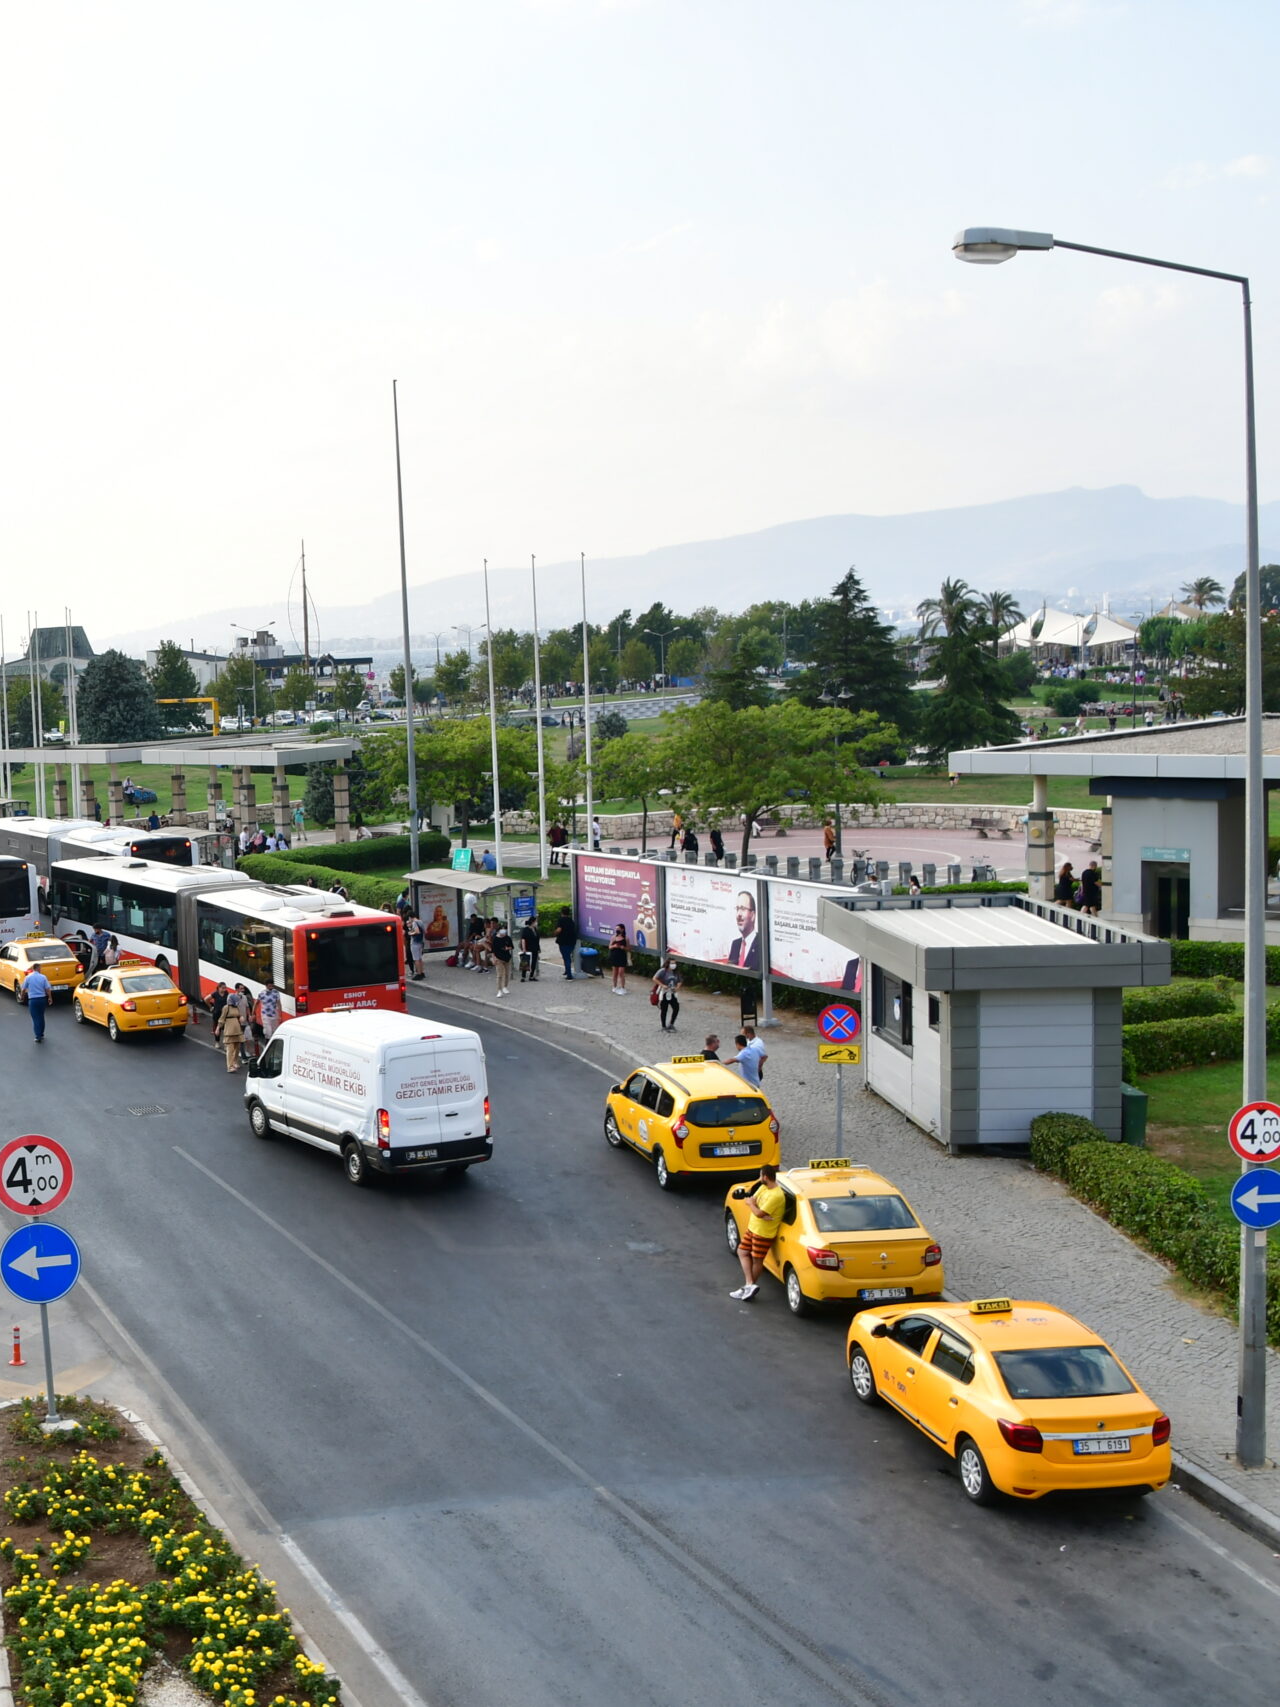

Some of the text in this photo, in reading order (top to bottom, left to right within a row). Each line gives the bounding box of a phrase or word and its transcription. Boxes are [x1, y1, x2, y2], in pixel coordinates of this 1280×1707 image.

[343, 991, 367, 999] ESHOT
[356, 1000, 377, 1008] ARAÇ
[1263, 1117, 1278, 1126] m
[35, 1154, 52, 1165] m
[1079, 1440, 1128, 1451] 35 T 6191
